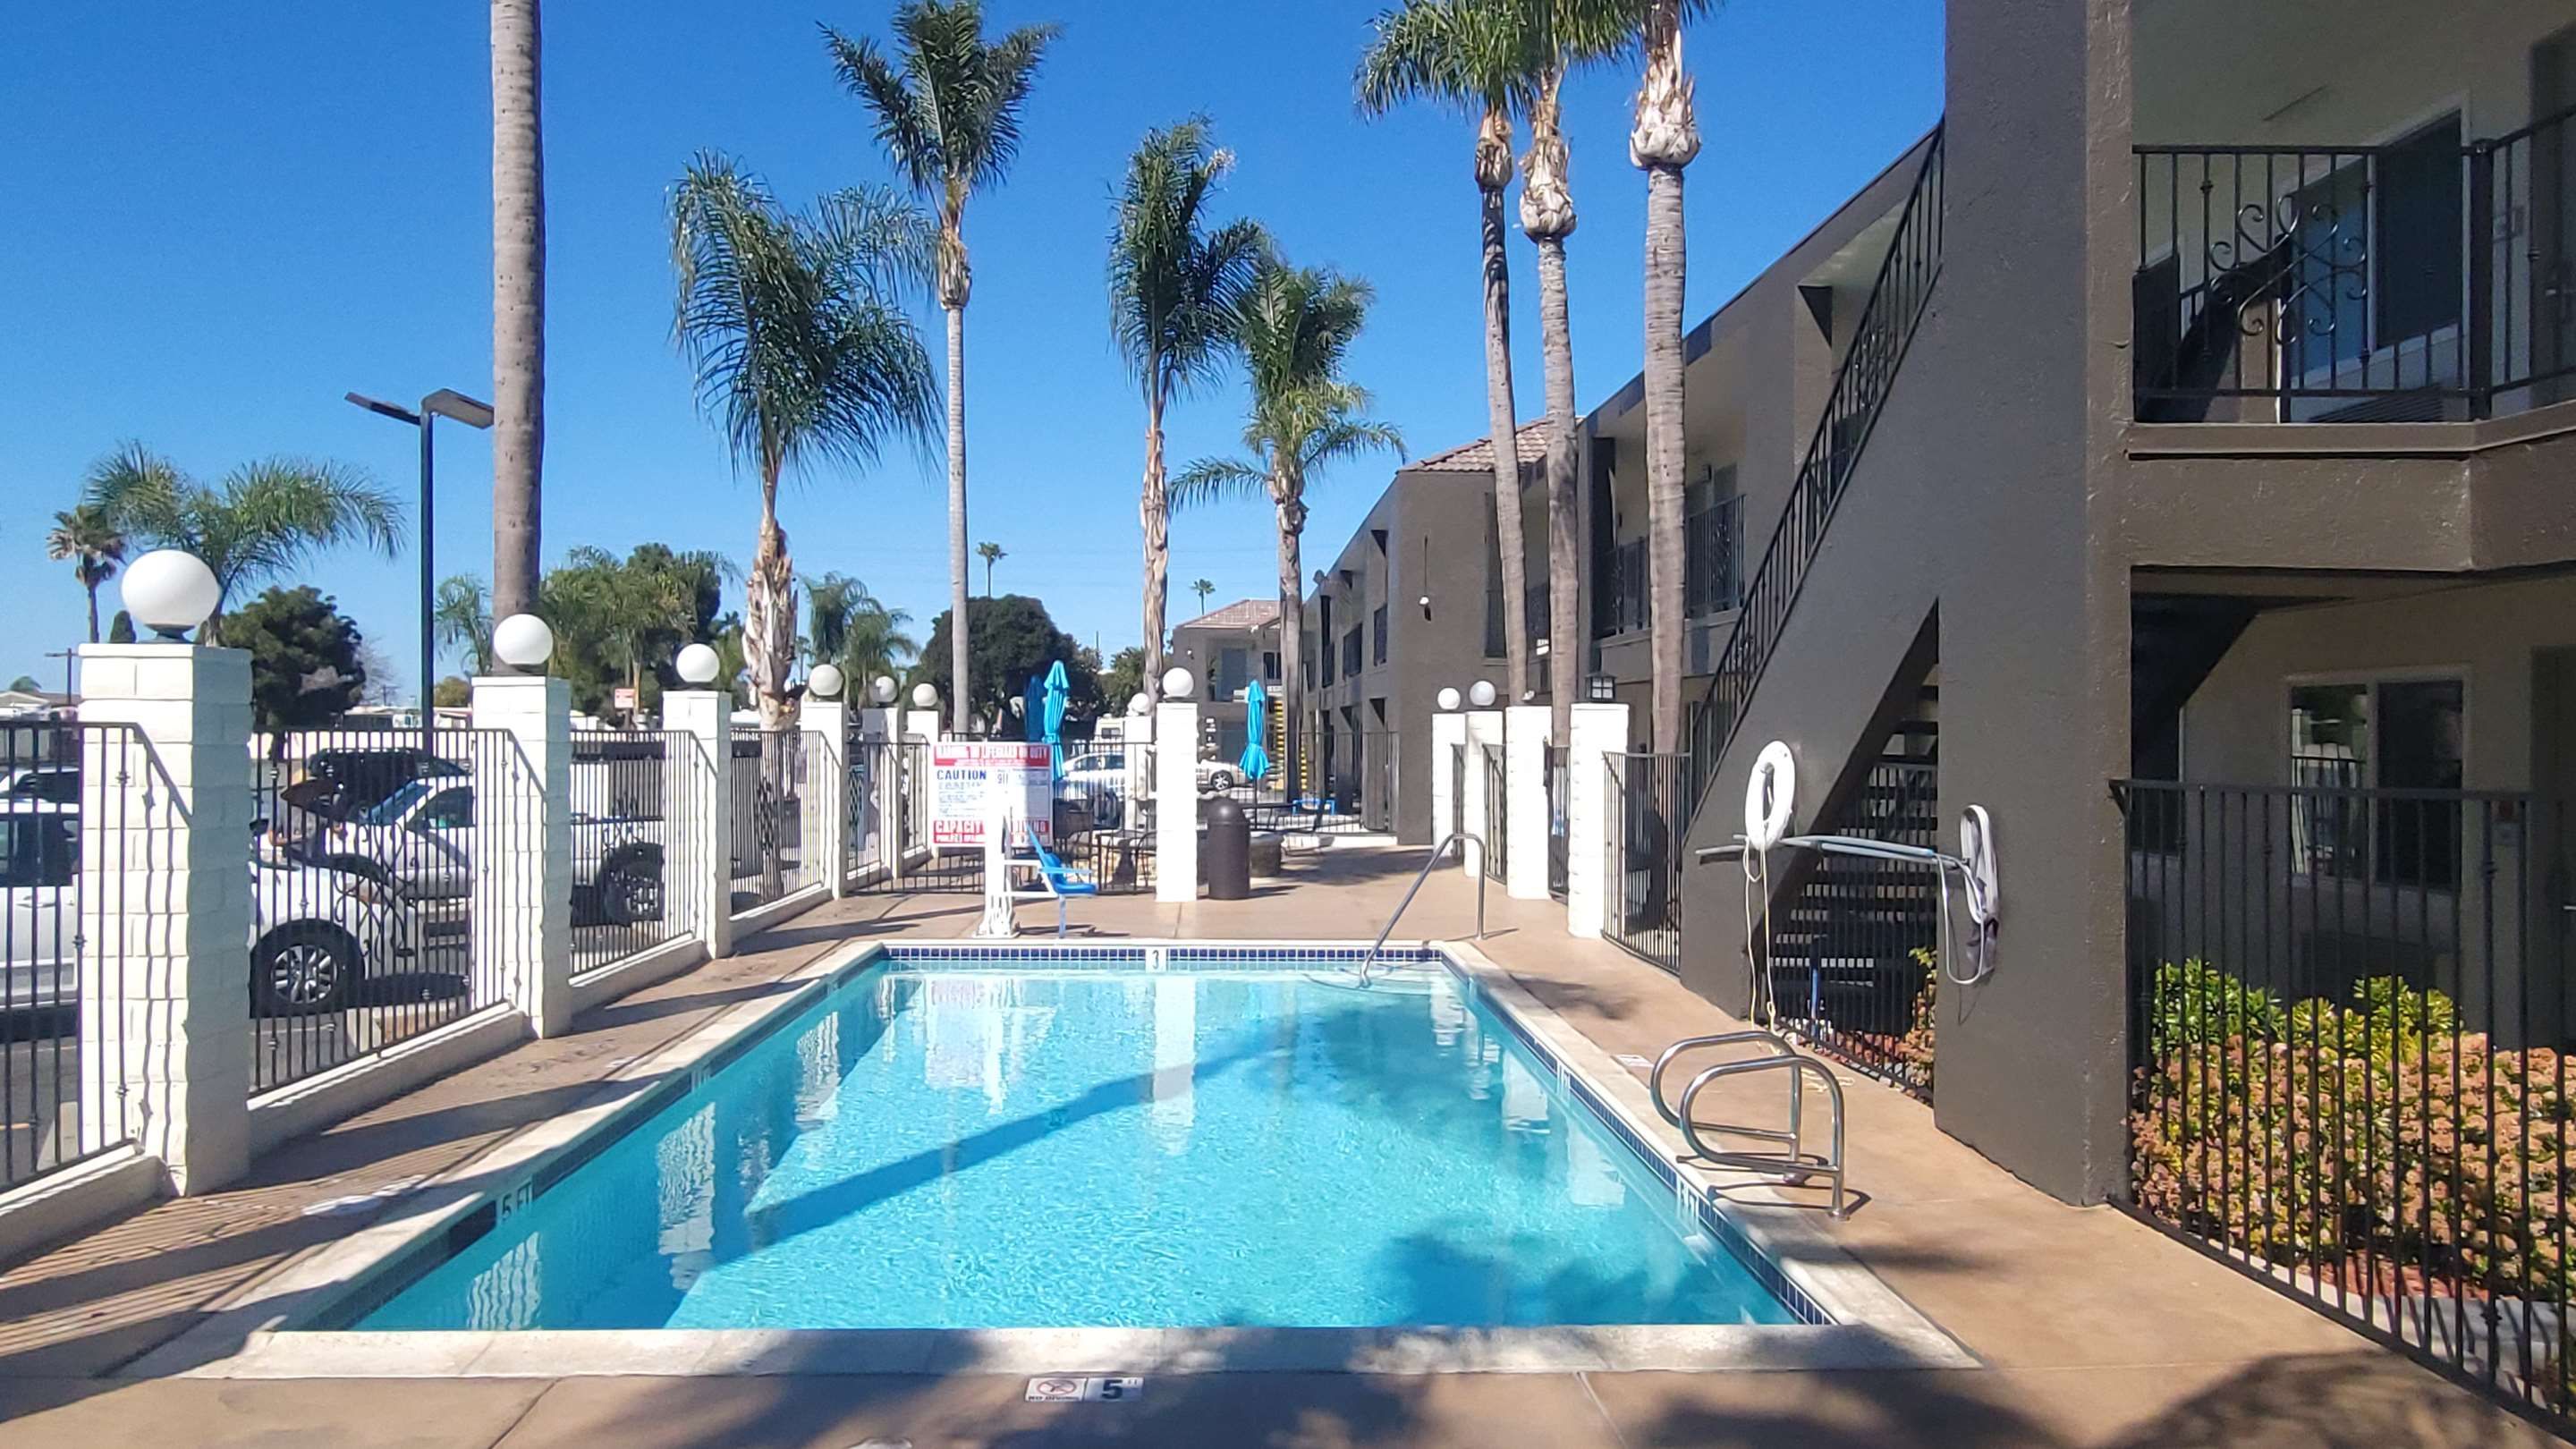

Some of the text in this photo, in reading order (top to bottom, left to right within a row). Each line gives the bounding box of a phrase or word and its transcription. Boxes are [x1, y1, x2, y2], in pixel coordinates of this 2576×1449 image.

[936, 769, 987, 781] CAUTION
[997, 774, 1009, 784] 911
[1101, 1379, 1123, 1400] 5
